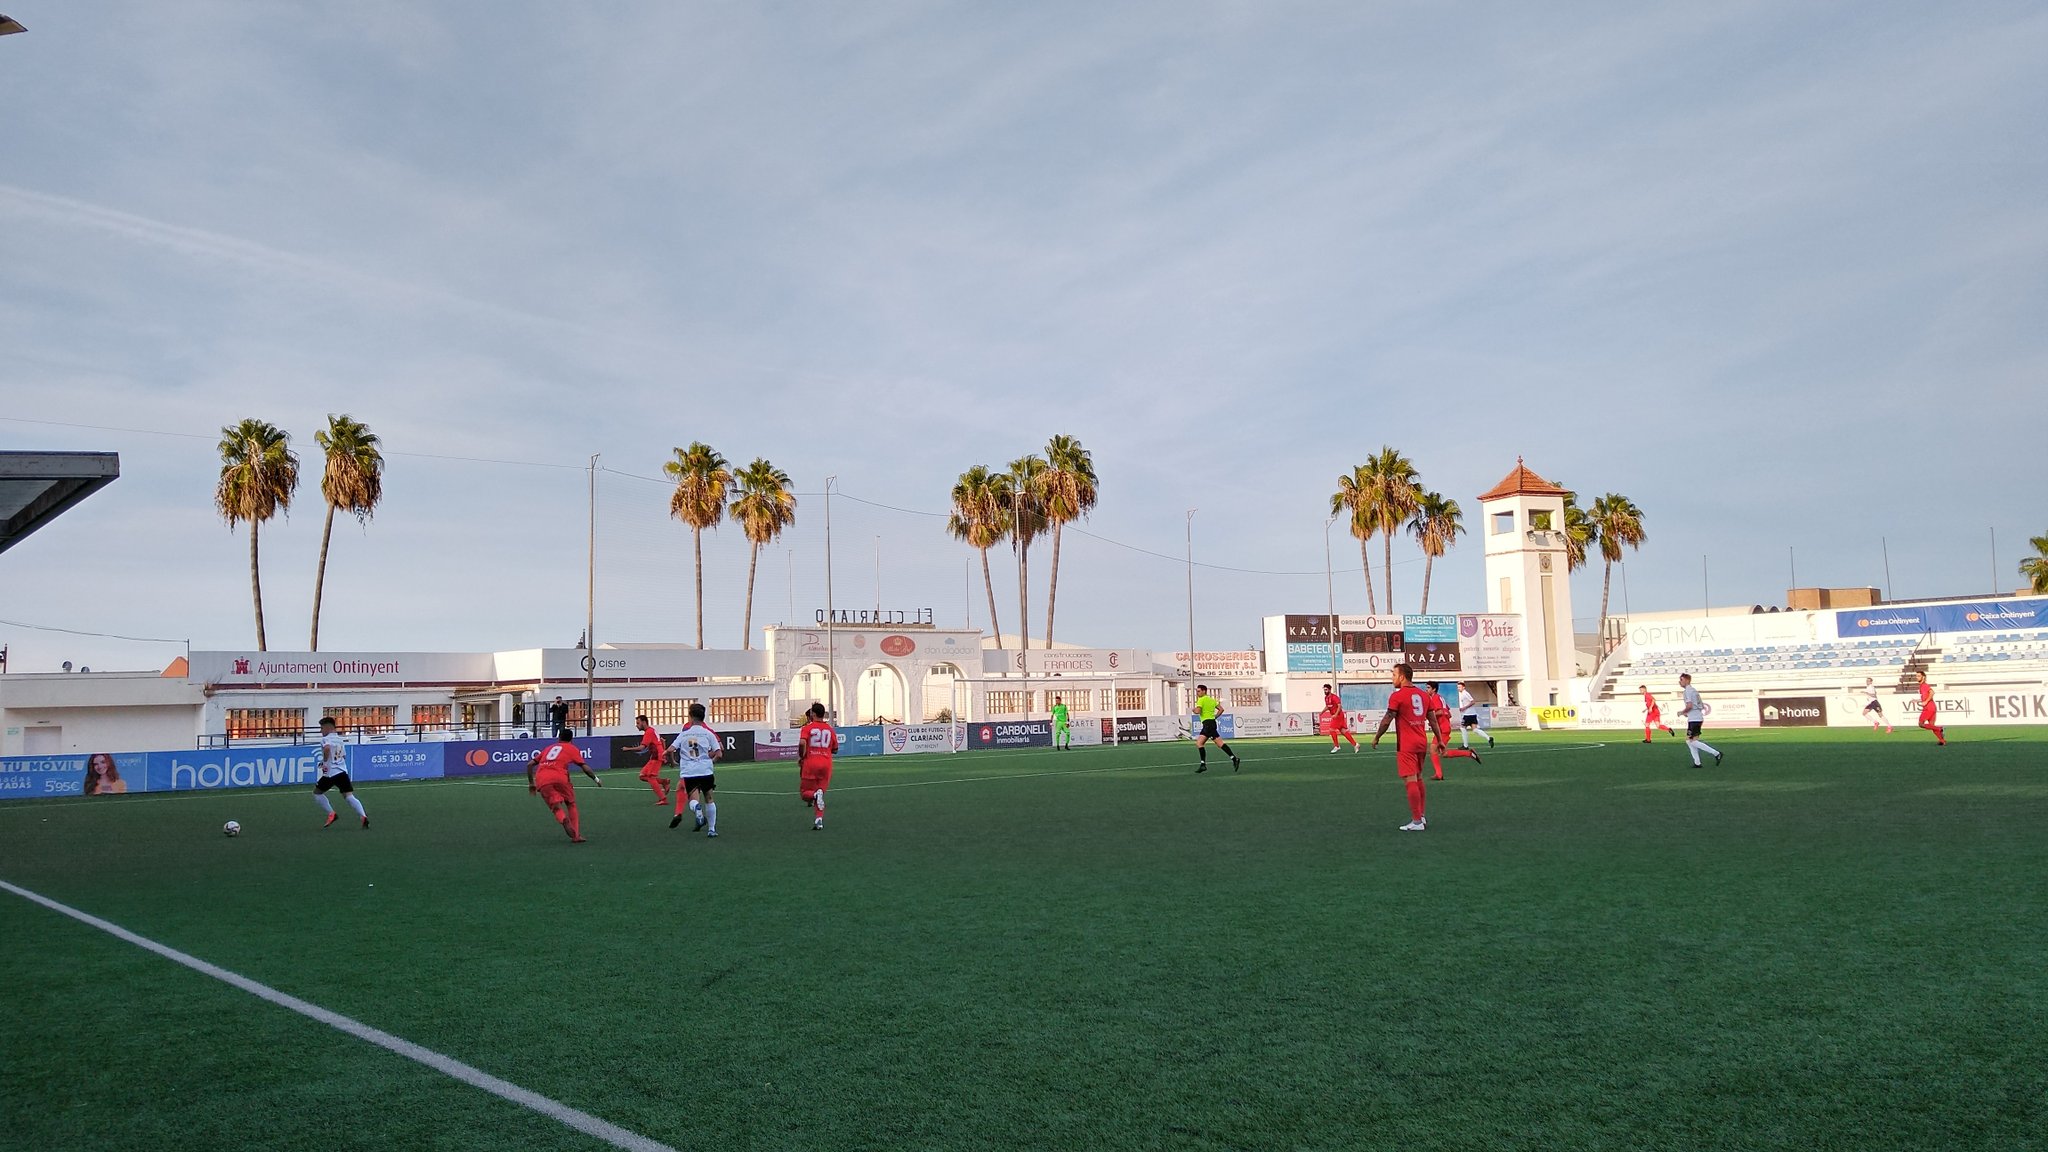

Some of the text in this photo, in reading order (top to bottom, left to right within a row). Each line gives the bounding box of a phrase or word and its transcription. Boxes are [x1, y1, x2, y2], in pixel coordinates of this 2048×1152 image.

[2000, 611, 2035, 619] Ontinyent
[1405, 616, 1455, 625] BABETECNO
[1888, 617, 1920, 625] Ontinyent
[1289, 626, 1339, 636] KAZAR
[1175, 652, 1257, 661] CARROSSERIES
[1408, 653, 1456, 662] KAZAR
[258, 660, 400, 677] Ajuntament Ontinyent
[598, 660, 627, 668] cisne
[1197, 662, 1240, 670] ONTINYENT
[1411, 693, 1424, 717] 9
[996, 723, 1048, 736] CARBONELL
[810, 728, 832, 748] 20
[910, 734, 944, 742] CLARIANO
[371, 753, 426, 763] 635 30 30 30
[492, 749, 528, 763] Caixa
[3, 757, 78, 772] TU MÓVIL
